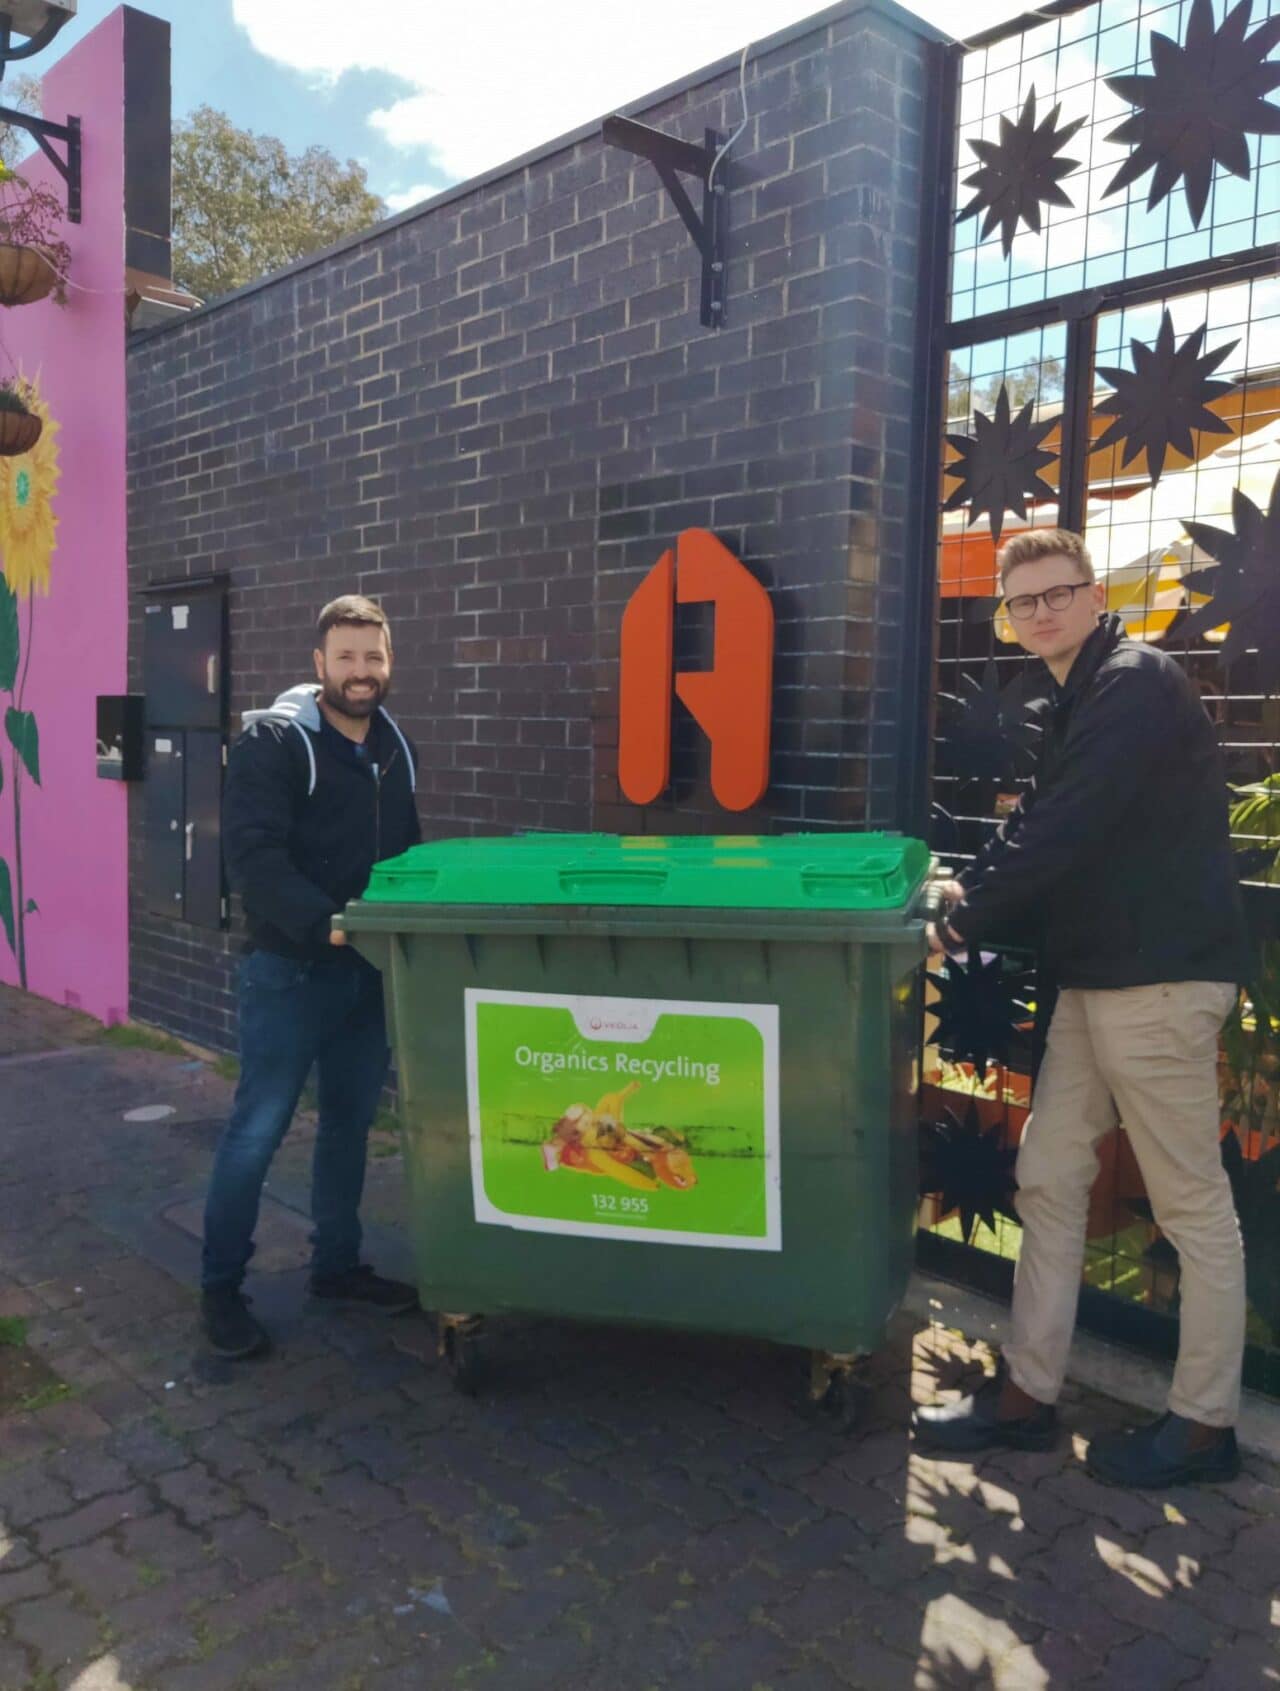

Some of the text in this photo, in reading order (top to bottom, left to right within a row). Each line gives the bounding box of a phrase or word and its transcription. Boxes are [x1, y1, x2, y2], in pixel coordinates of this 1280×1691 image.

[515, 1046, 720, 1085] Organics Recycling
[592, 1194, 649, 1213] 132 955
